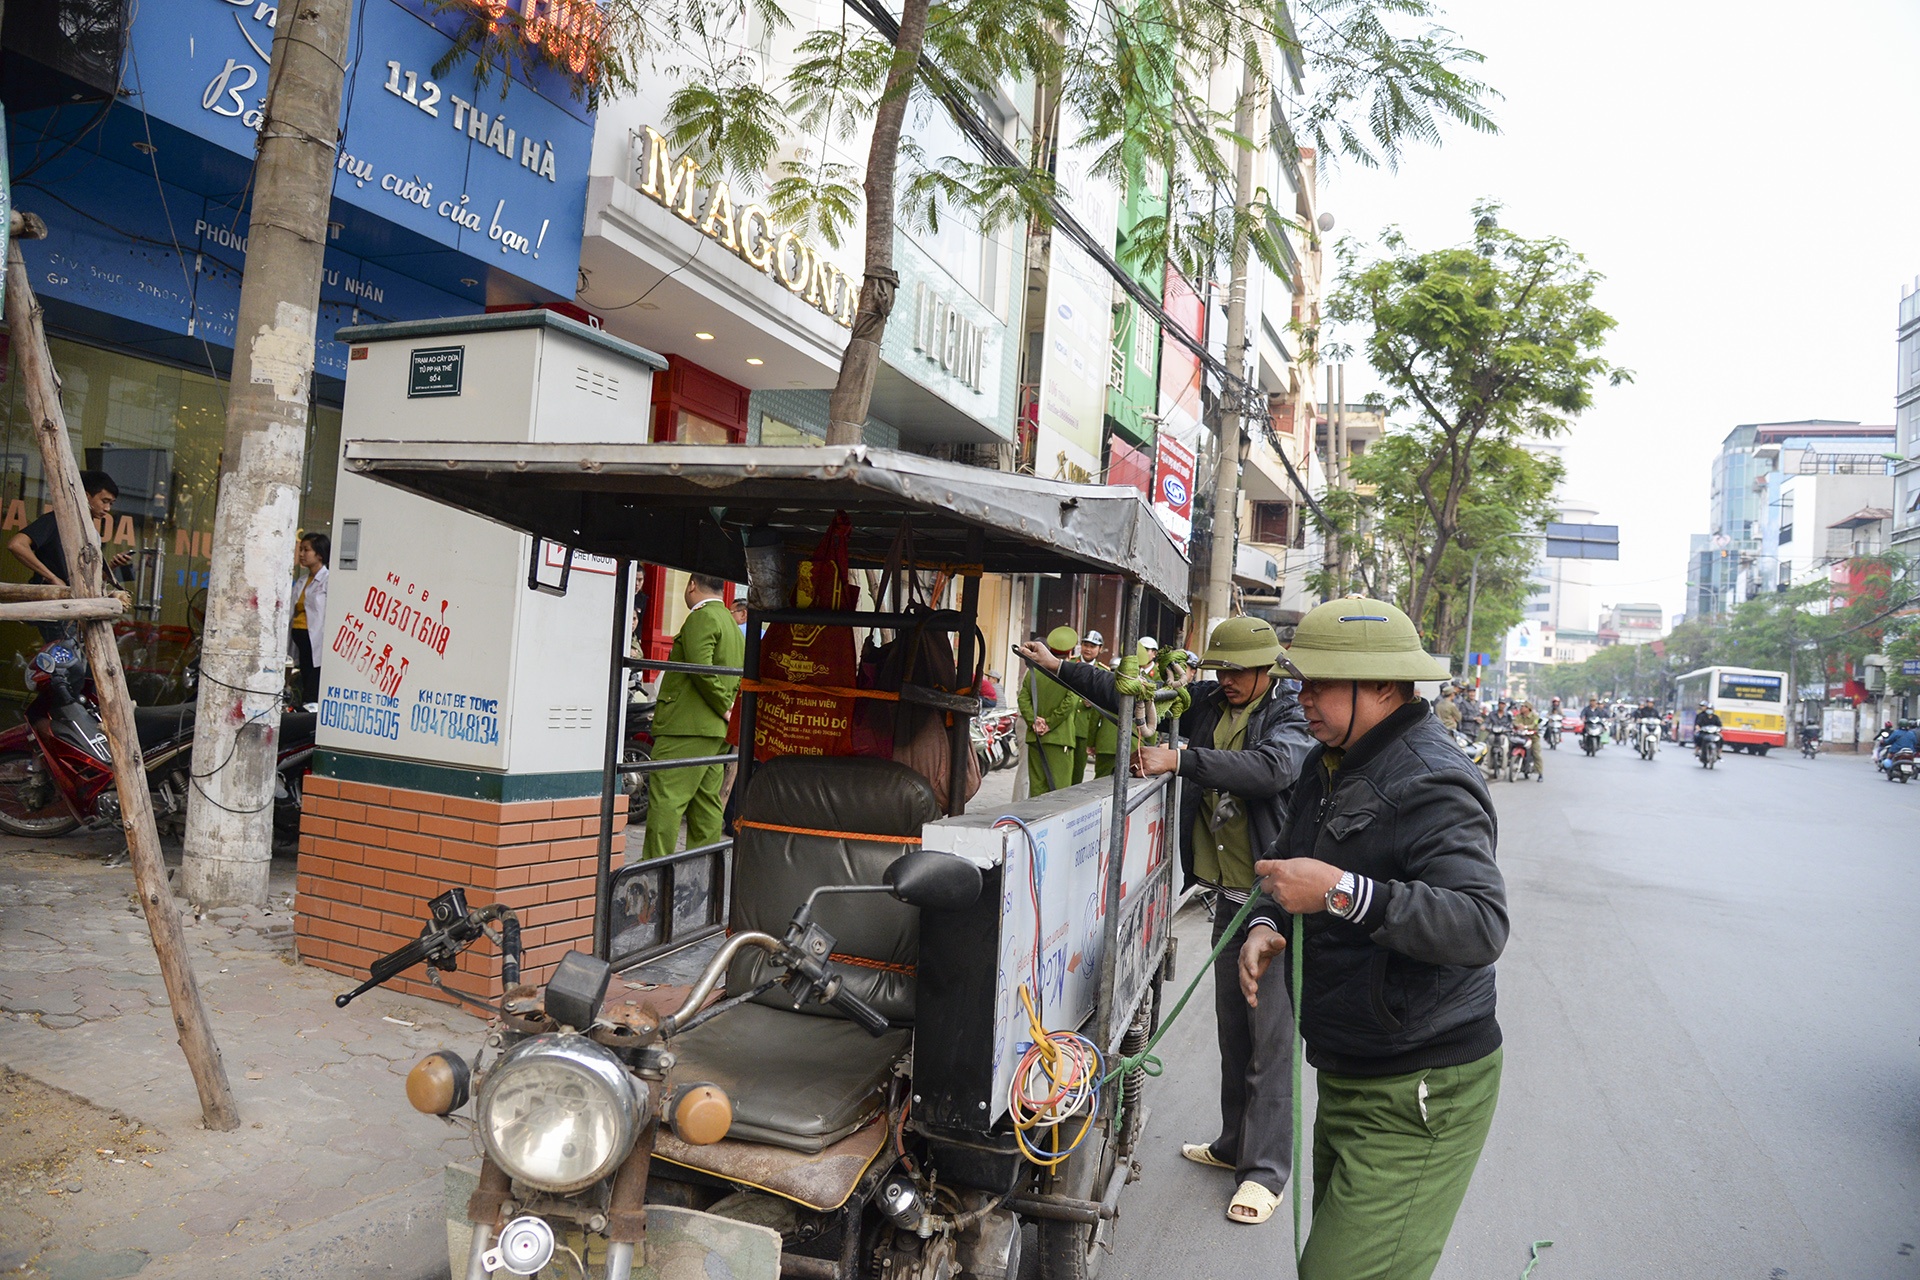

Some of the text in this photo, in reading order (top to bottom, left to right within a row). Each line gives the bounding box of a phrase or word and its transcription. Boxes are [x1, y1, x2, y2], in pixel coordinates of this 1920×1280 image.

[383, 60, 556, 182] 112 THÁI HÀ
[381, 174, 434, 210] cười
[438, 194, 481, 232] của
[344, 277, 384, 303] NHÂN
[0, 498, 28, 532] A
[386, 571, 401, 587] KH
[364, 586, 451, 656] 0913076118
[327, 685, 400, 708] KH CAT BE TONG
[418, 689, 499, 715] KH CAT BE TONG
[819, 699, 837, 709] VIÊN
[320, 698, 400, 741] 0916305505
[410, 703, 499, 746] 0947848134
[807, 712, 829, 727] THỦ
[831, 716, 848, 729] ĐÔ
